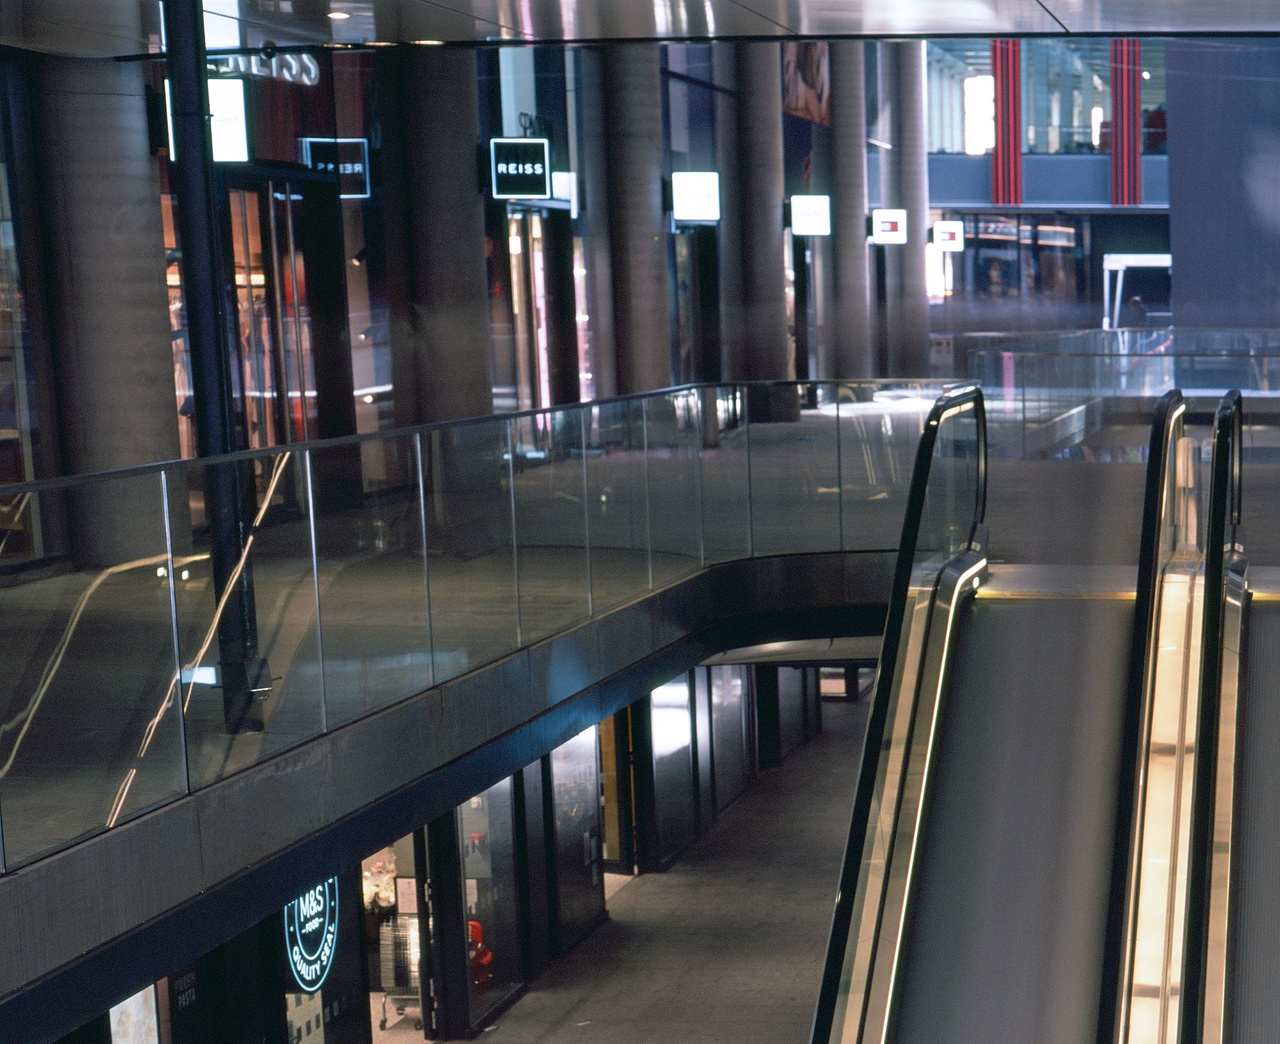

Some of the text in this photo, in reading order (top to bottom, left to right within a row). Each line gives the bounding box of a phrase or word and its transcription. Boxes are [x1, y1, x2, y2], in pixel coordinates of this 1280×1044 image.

[497, 163, 543, 174] REISS
[300, 885, 324, 922] M&S
[293, 923, 335, 980] QUALITY SEAL
